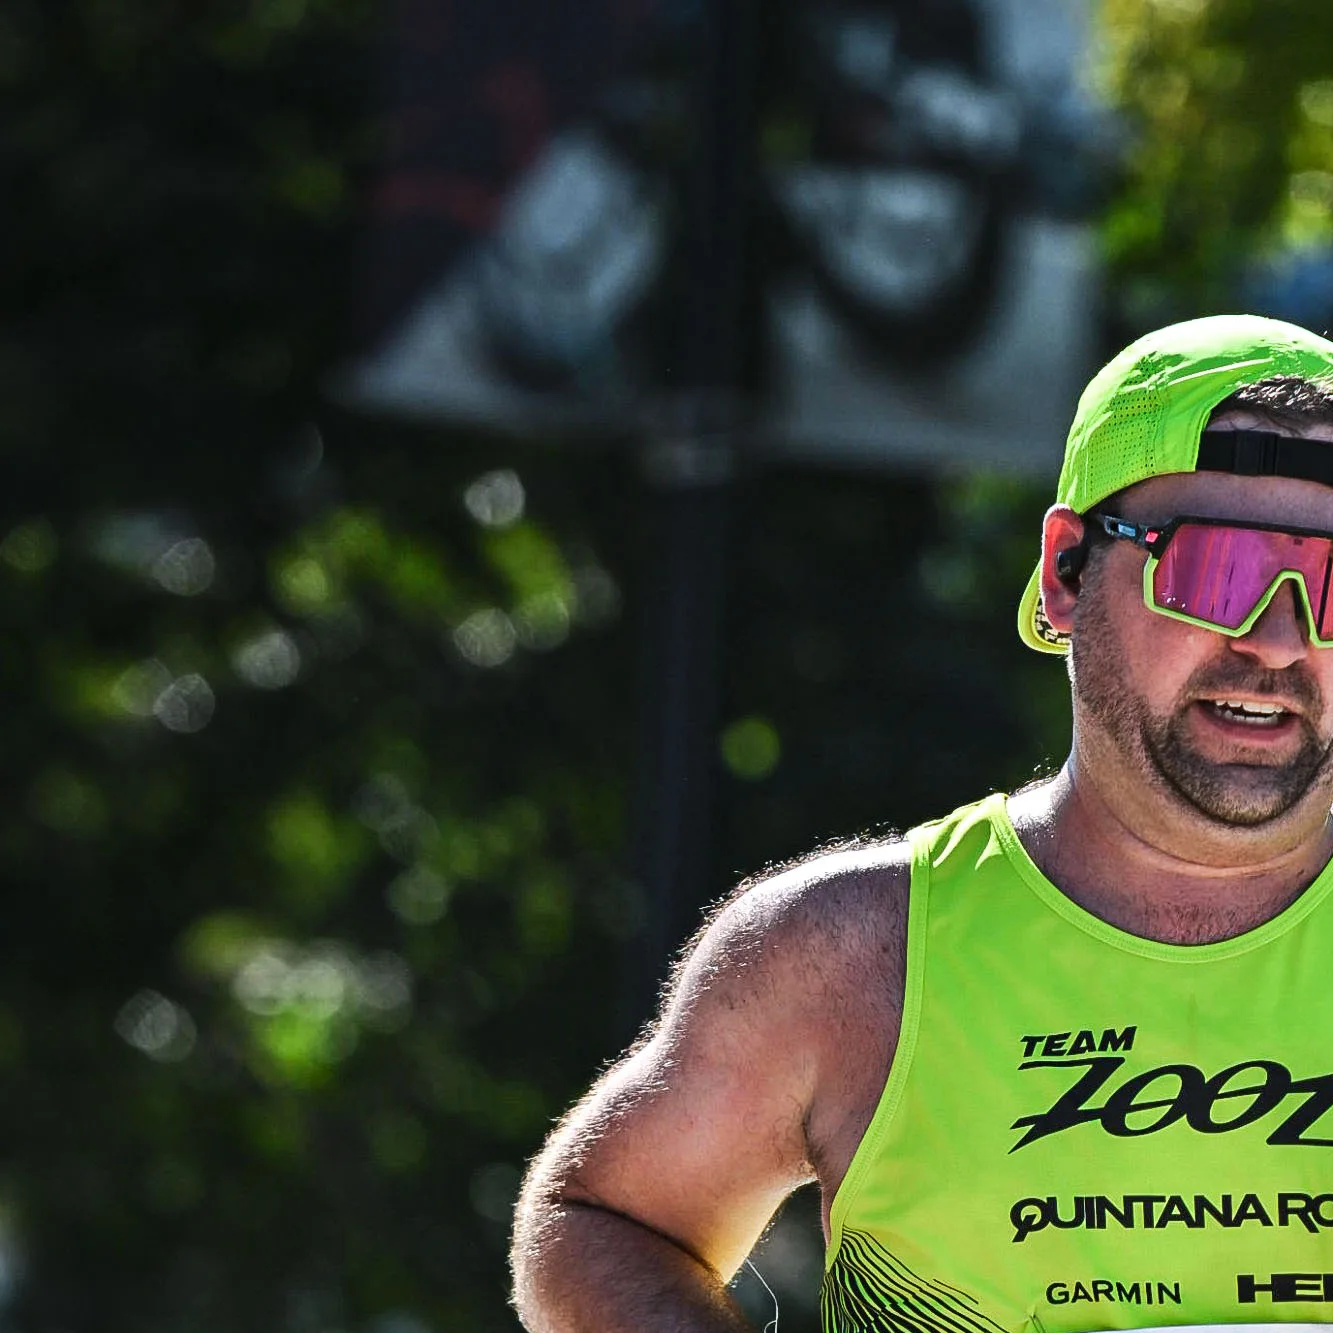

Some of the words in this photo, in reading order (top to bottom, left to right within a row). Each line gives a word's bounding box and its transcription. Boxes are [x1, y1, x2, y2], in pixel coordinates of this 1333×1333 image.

[1020, 1026, 1138, 1057] TEAM
[1010, 1194, 1274, 1242] QUINTANA
[1046, 1280, 1181, 1304] GARMIN
